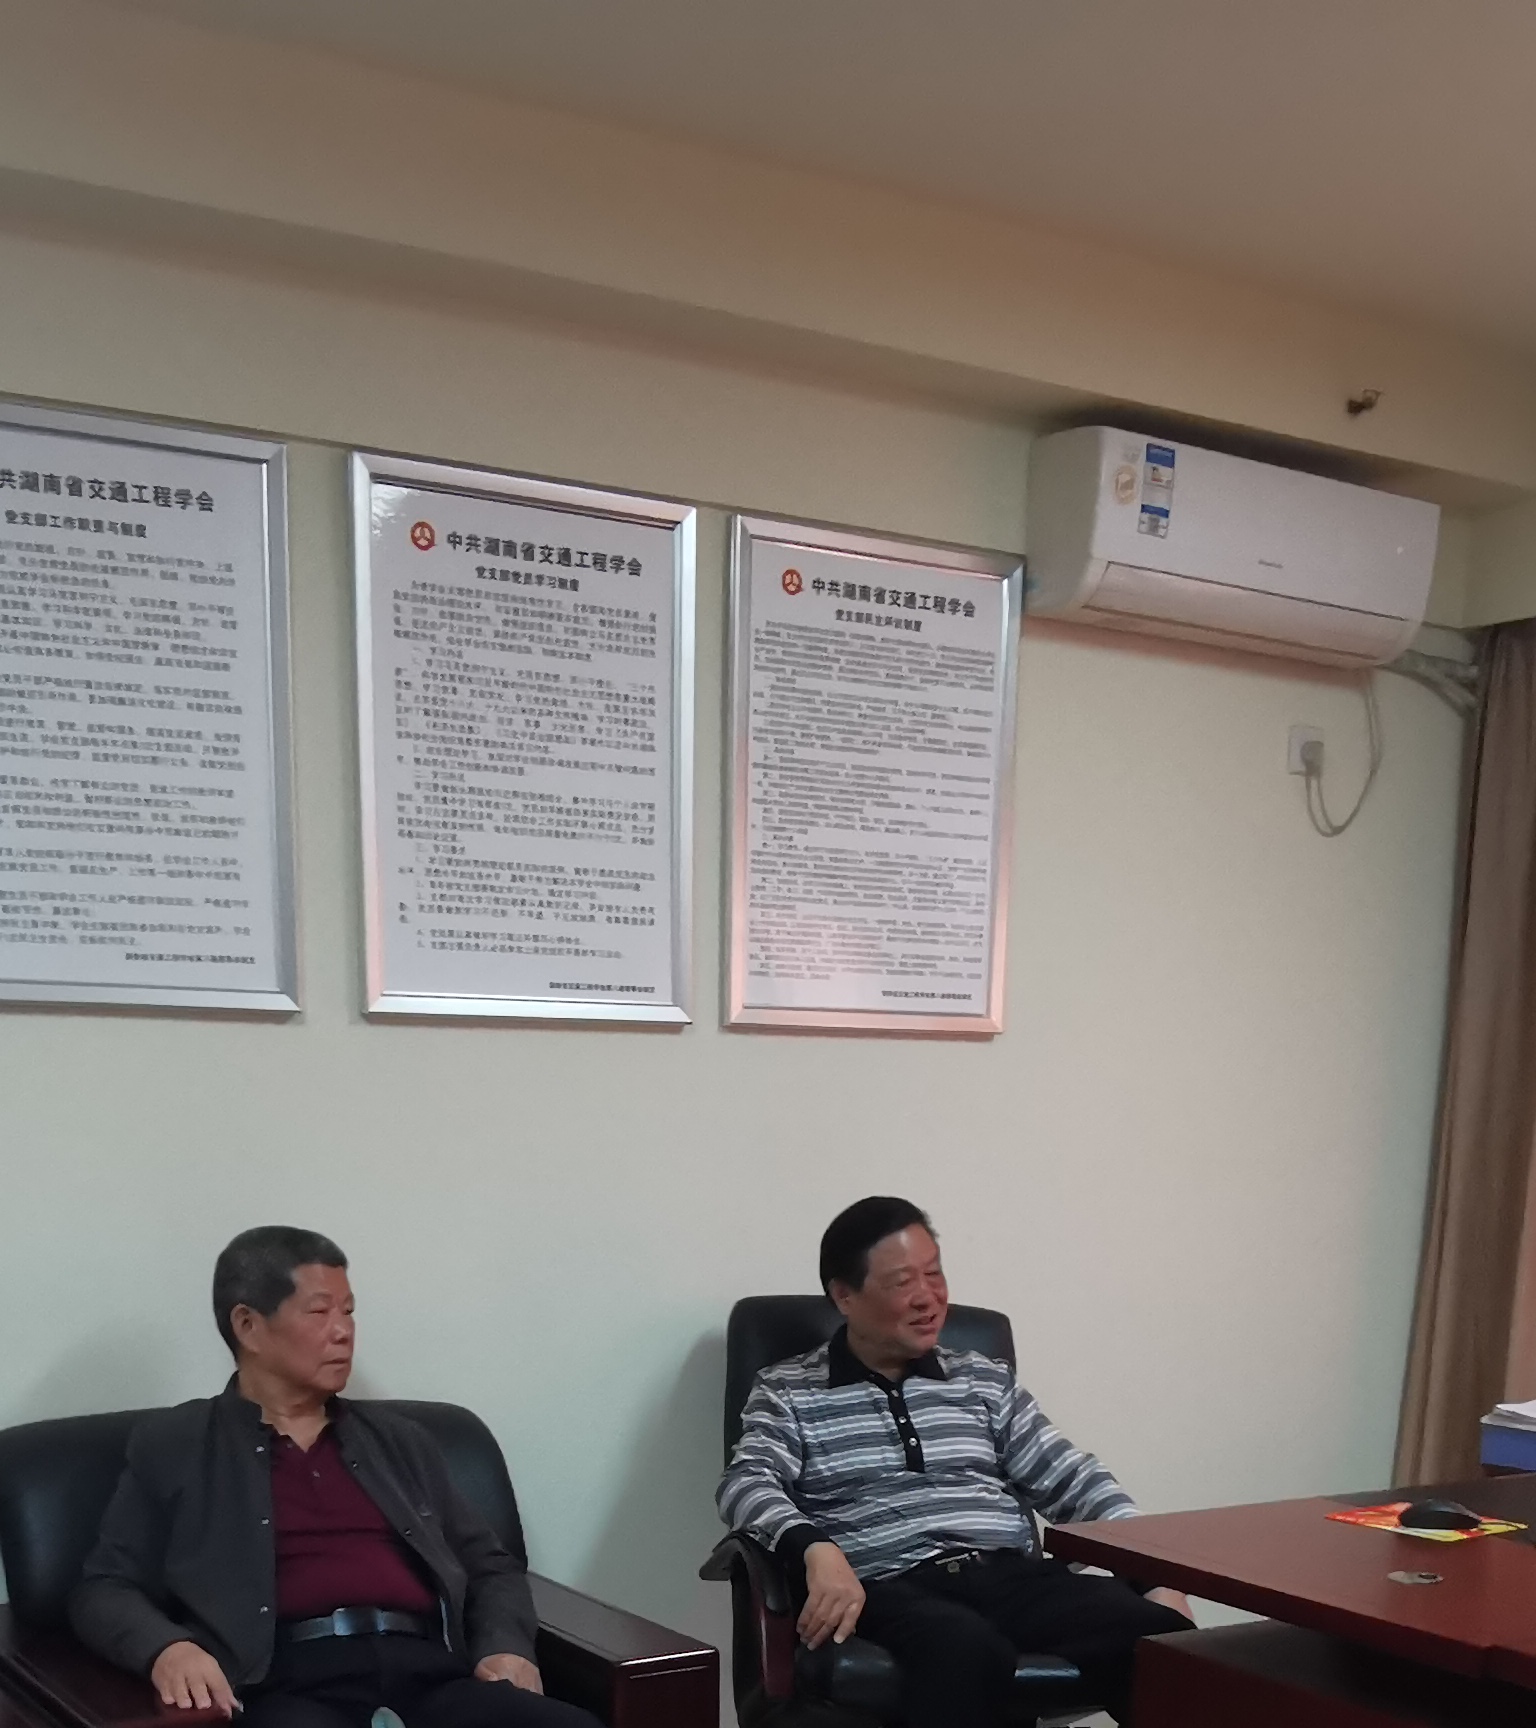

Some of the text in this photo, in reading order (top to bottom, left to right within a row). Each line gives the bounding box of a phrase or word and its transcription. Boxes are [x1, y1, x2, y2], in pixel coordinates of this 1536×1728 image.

[447, 530, 643, 577] 中共湖南省交通工程学会
[811, 576, 976, 618] 中共湖南省交通工程学会
